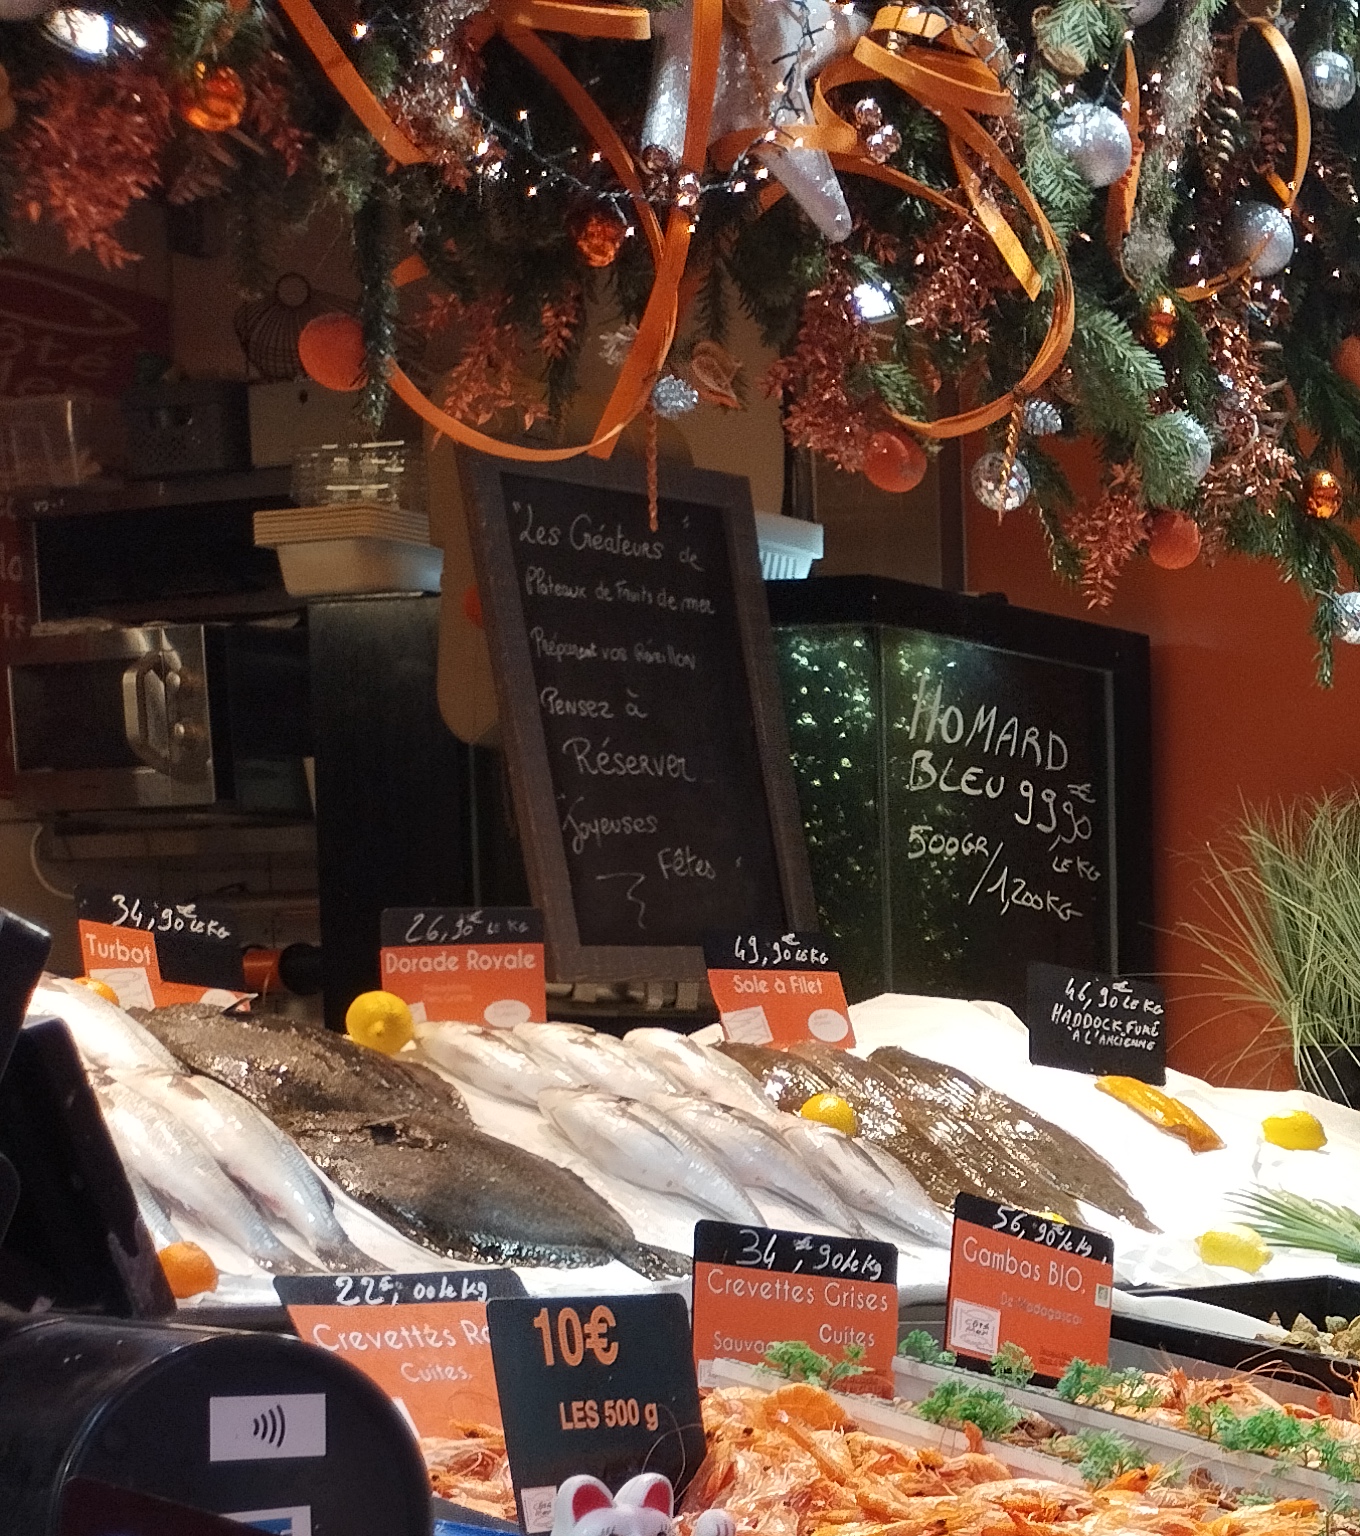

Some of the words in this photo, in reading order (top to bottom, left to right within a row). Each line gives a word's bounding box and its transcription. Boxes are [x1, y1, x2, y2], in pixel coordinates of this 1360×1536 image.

[570, 513, 663, 560] Créateurs
[679, 546, 706, 572] de
[656, 591, 677, 612] de
[680, 594, 715, 615] mer
[540, 687, 614, 720] Pensez
[625, 688, 648, 720] à
[908, 674, 1069, 772] HOMARD
[562, 736, 696, 783] Réserver
[909, 749, 1005, 799] BLEU
[563, 797, 658, 855] Joyeuses
[656, 846, 717, 880] Fêtes
[1052, 856, 1073, 873] LE
[1077, 856, 1102, 882] KG
[86, 932, 154, 965] Turbot
[385, 950, 460, 976] Dorade
[467, 948, 537, 974] Royale
[732, 974, 770, 996] Sole
[773, 973, 787, 995] à
[789, 973, 823, 996] Filet
[1051, 1002, 1123, 1032] HADDOCK
[963, 1236, 1041, 1282] Gambas
[706, 1269, 815, 1304] Crevettes
[824, 1281, 889, 1312] Grises
[312, 1323, 457, 1351] Crevettes
[533, 1305, 620, 1369] 10€
[818, 1323, 877, 1347] Cuites
[559, 1401, 601, 1432] LES
[604, 1398, 641, 1429] 500
[645, 1401, 660, 1432] g
